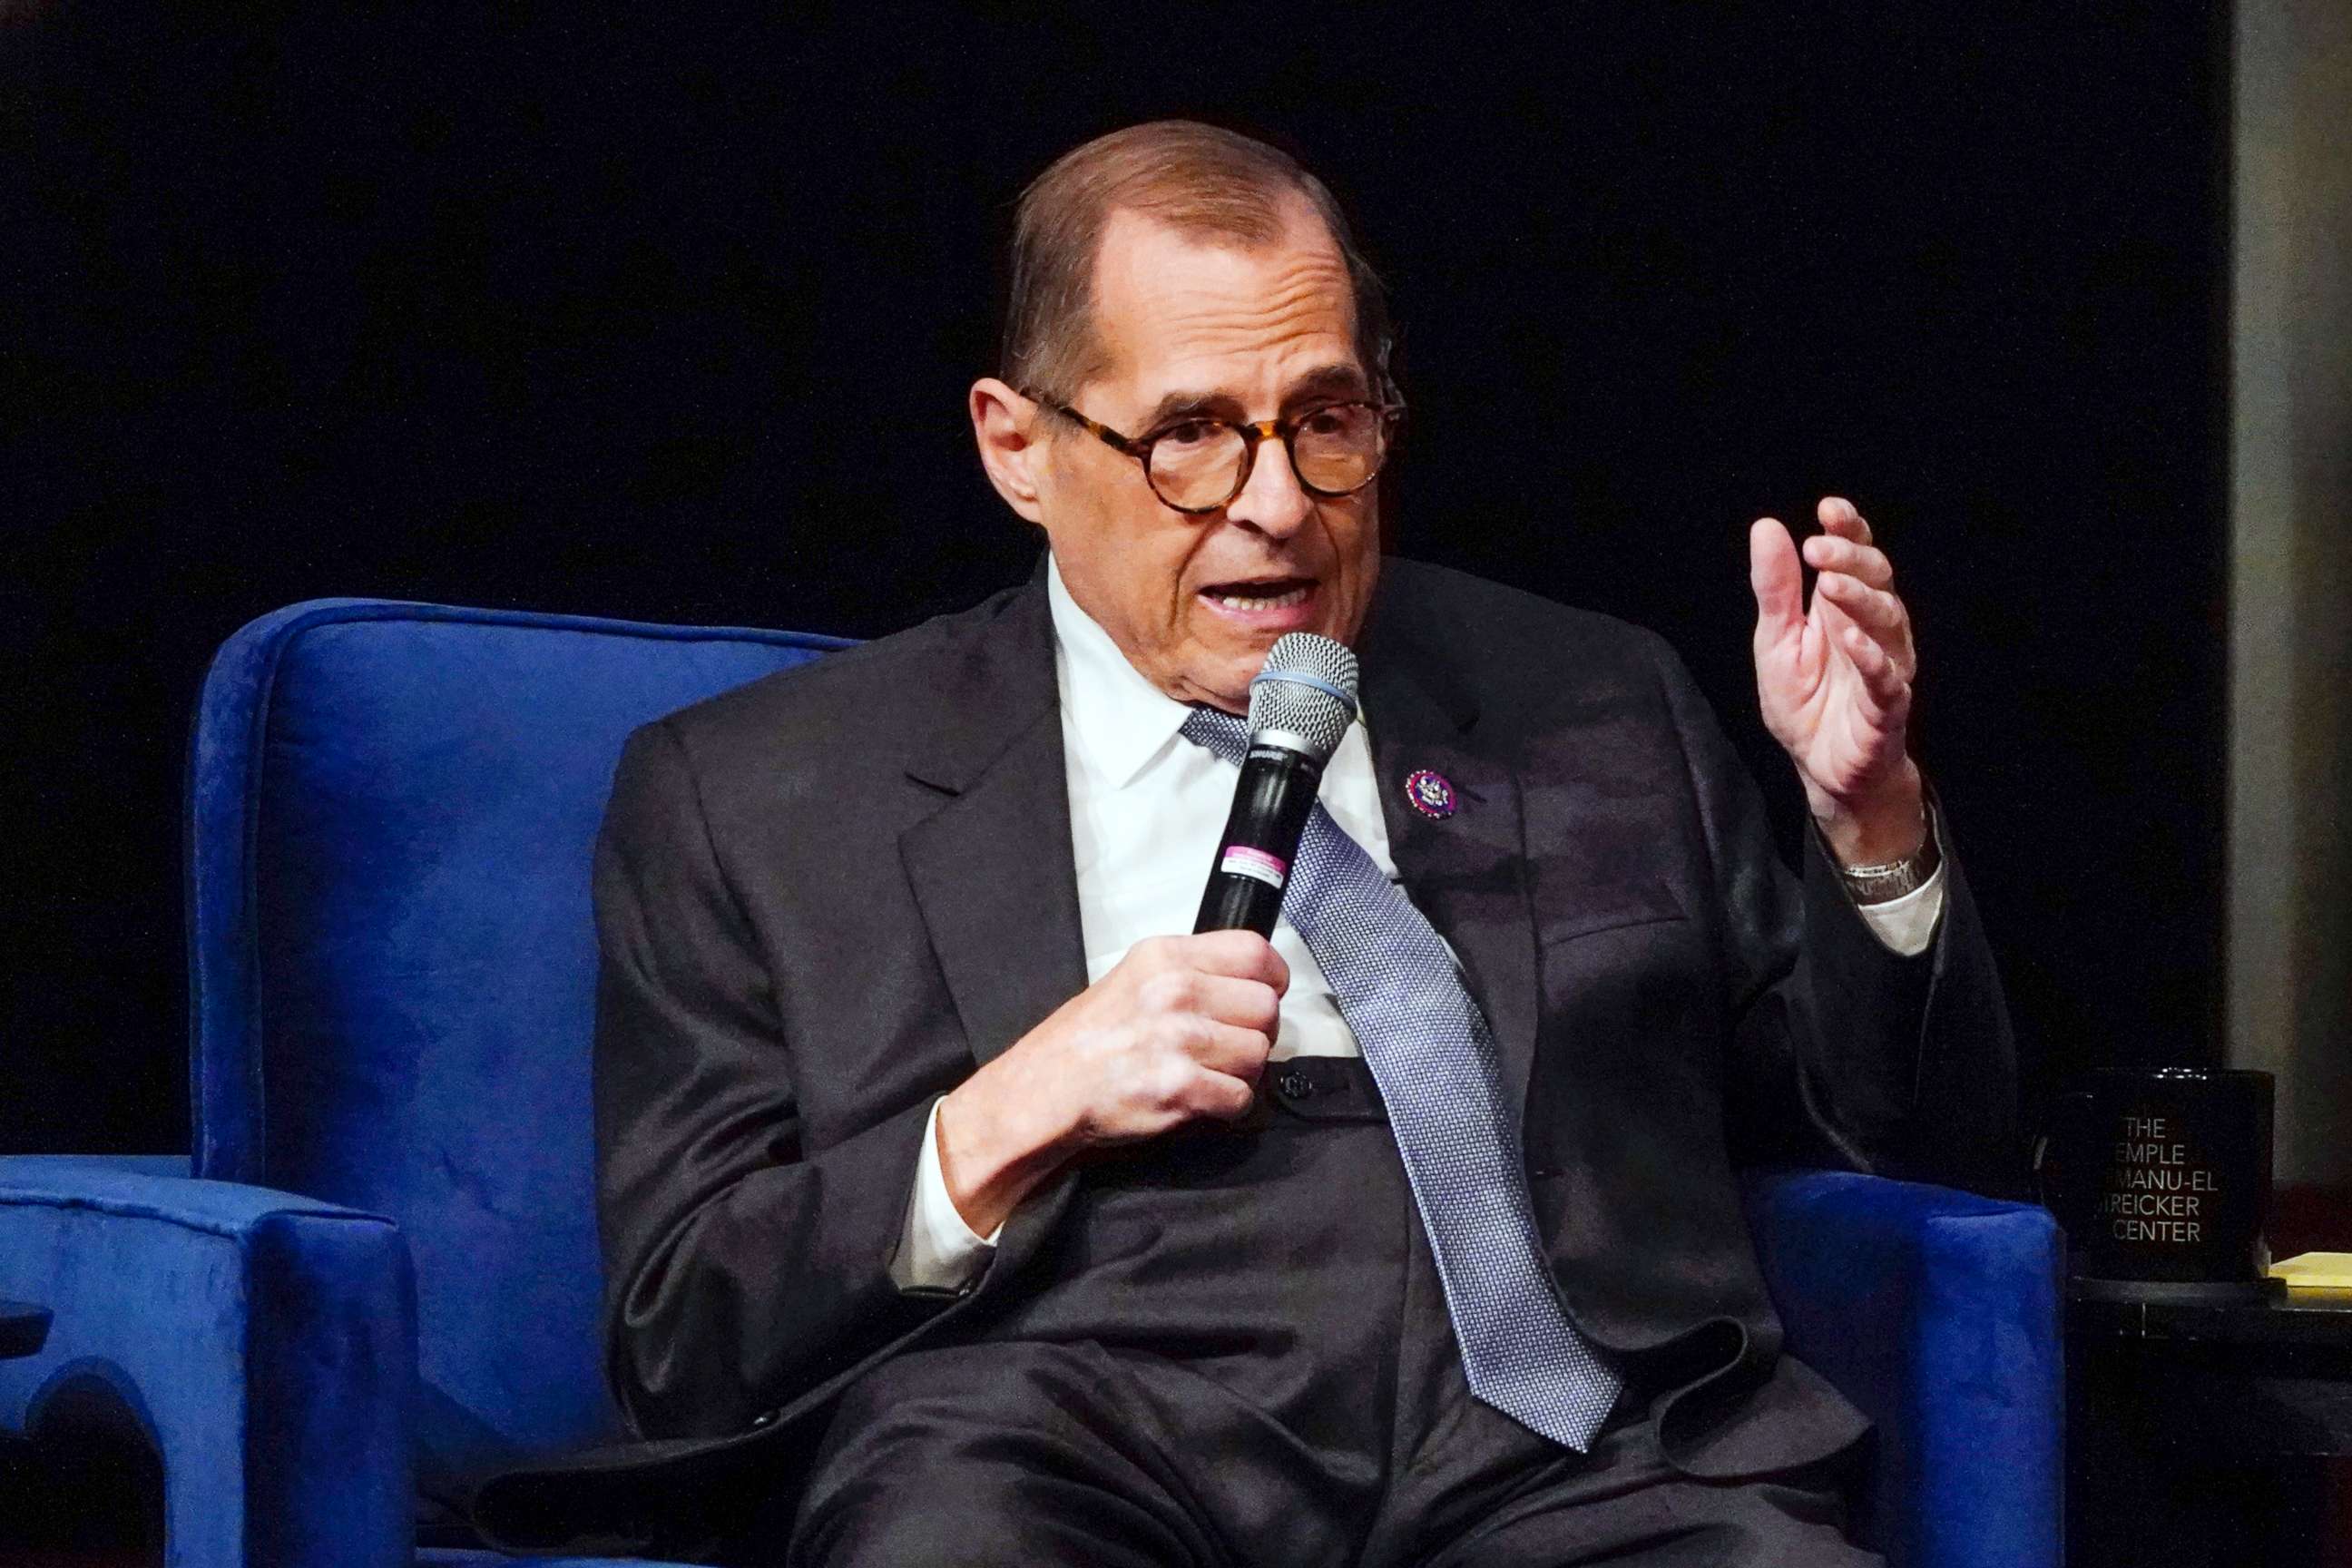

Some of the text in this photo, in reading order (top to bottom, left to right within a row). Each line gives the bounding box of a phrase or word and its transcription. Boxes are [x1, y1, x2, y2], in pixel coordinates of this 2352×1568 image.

[2123, 1117, 2166, 1139] THE
[2114, 1142, 2185, 1165] EMPLE
[2118, 1168, 2220, 1192] MANU-EL
[2104, 1193, 2200, 1217] TREICKER
[2112, 1219, 2200, 1242] CENTER
